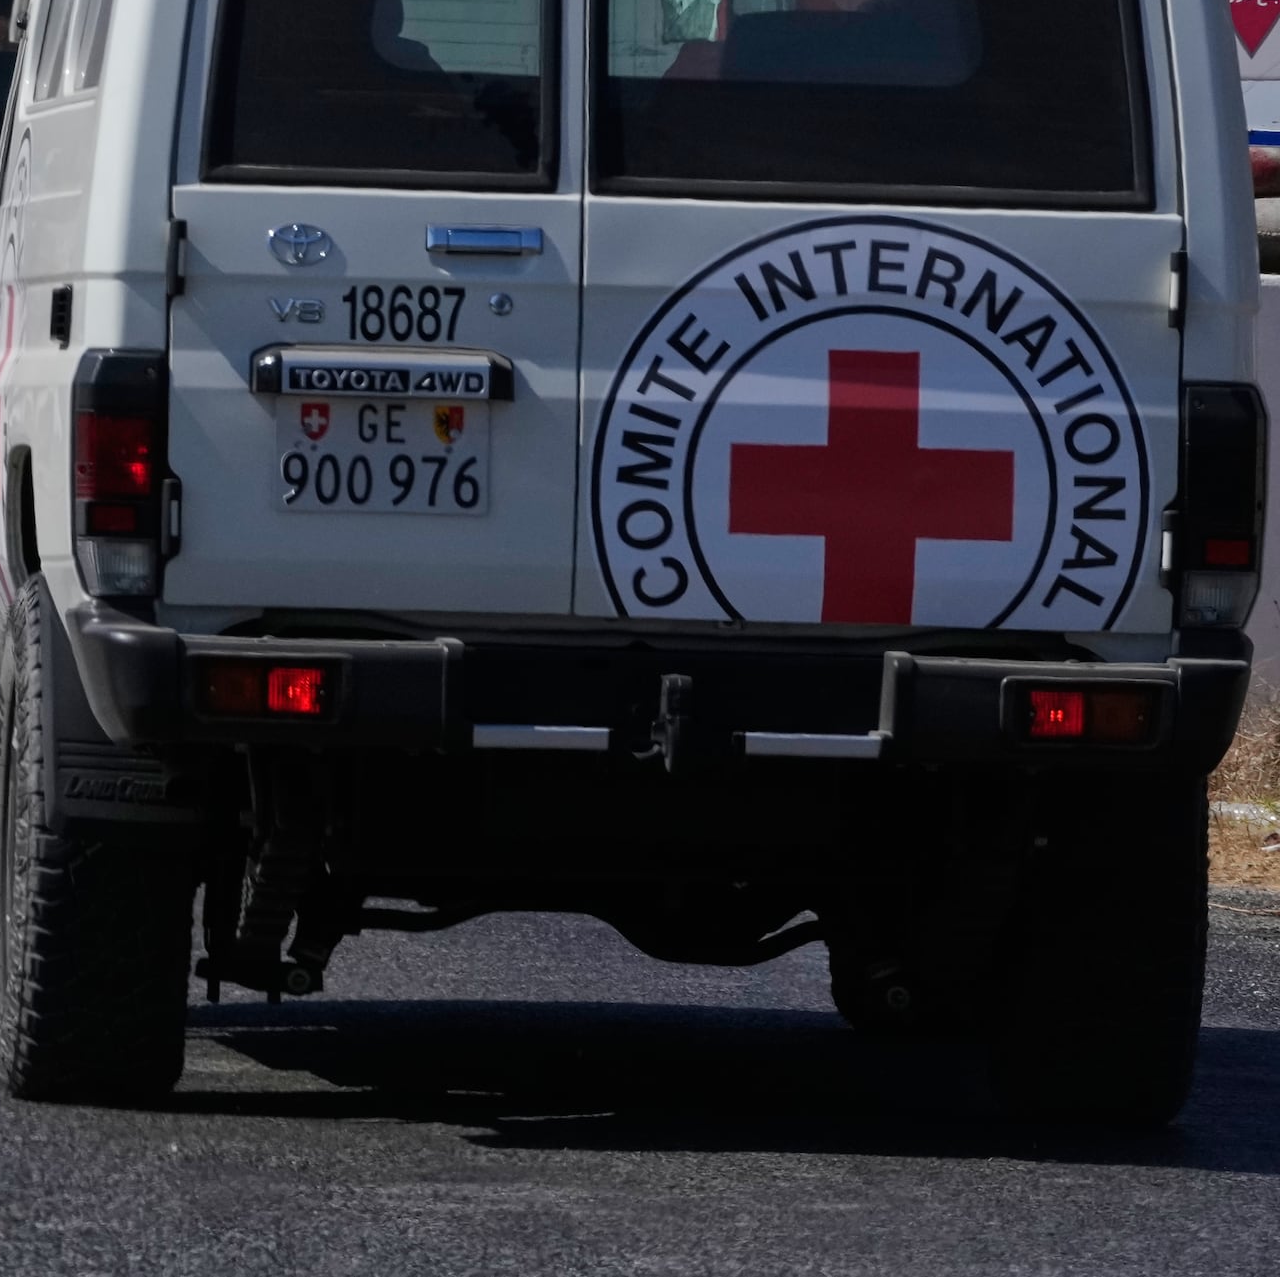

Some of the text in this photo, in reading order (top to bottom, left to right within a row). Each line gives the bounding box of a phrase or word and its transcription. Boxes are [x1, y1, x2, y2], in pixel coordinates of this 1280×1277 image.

[341, 284, 466, 342] 18687
[294, 368, 486, 395] TOYOTA 4WD
[357, 403, 407, 445] GE
[616, 239, 1127, 610] COMITE INTERNATIONAL
[281, 452, 481, 510] 900 976
